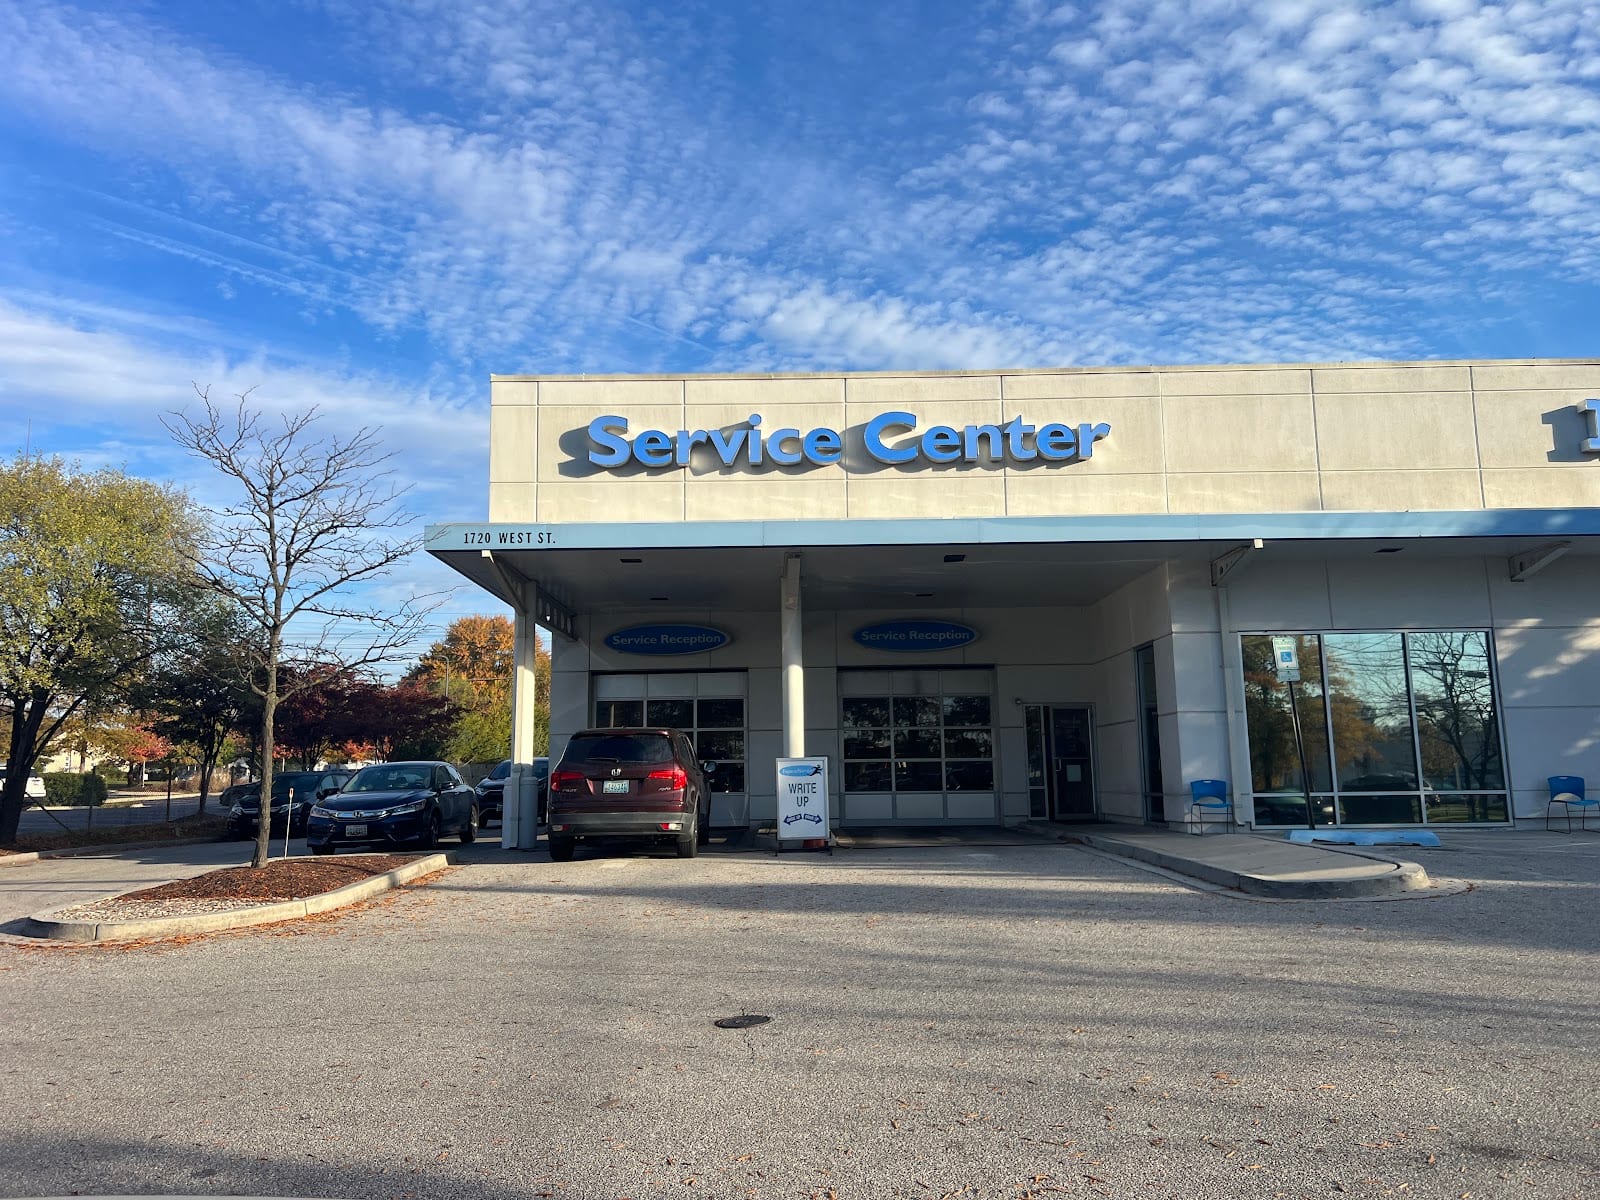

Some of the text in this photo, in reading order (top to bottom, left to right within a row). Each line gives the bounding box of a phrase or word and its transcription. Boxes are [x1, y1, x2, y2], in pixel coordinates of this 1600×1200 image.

[587, 411, 1112, 467] Service Center
[464, 532, 556, 544] 1720 WEST ST.
[612, 633, 721, 646] Service Reception
[861, 629, 970, 643] Service Reception
[788, 782, 817, 794] WRITE
[796, 796, 809, 807] UP
